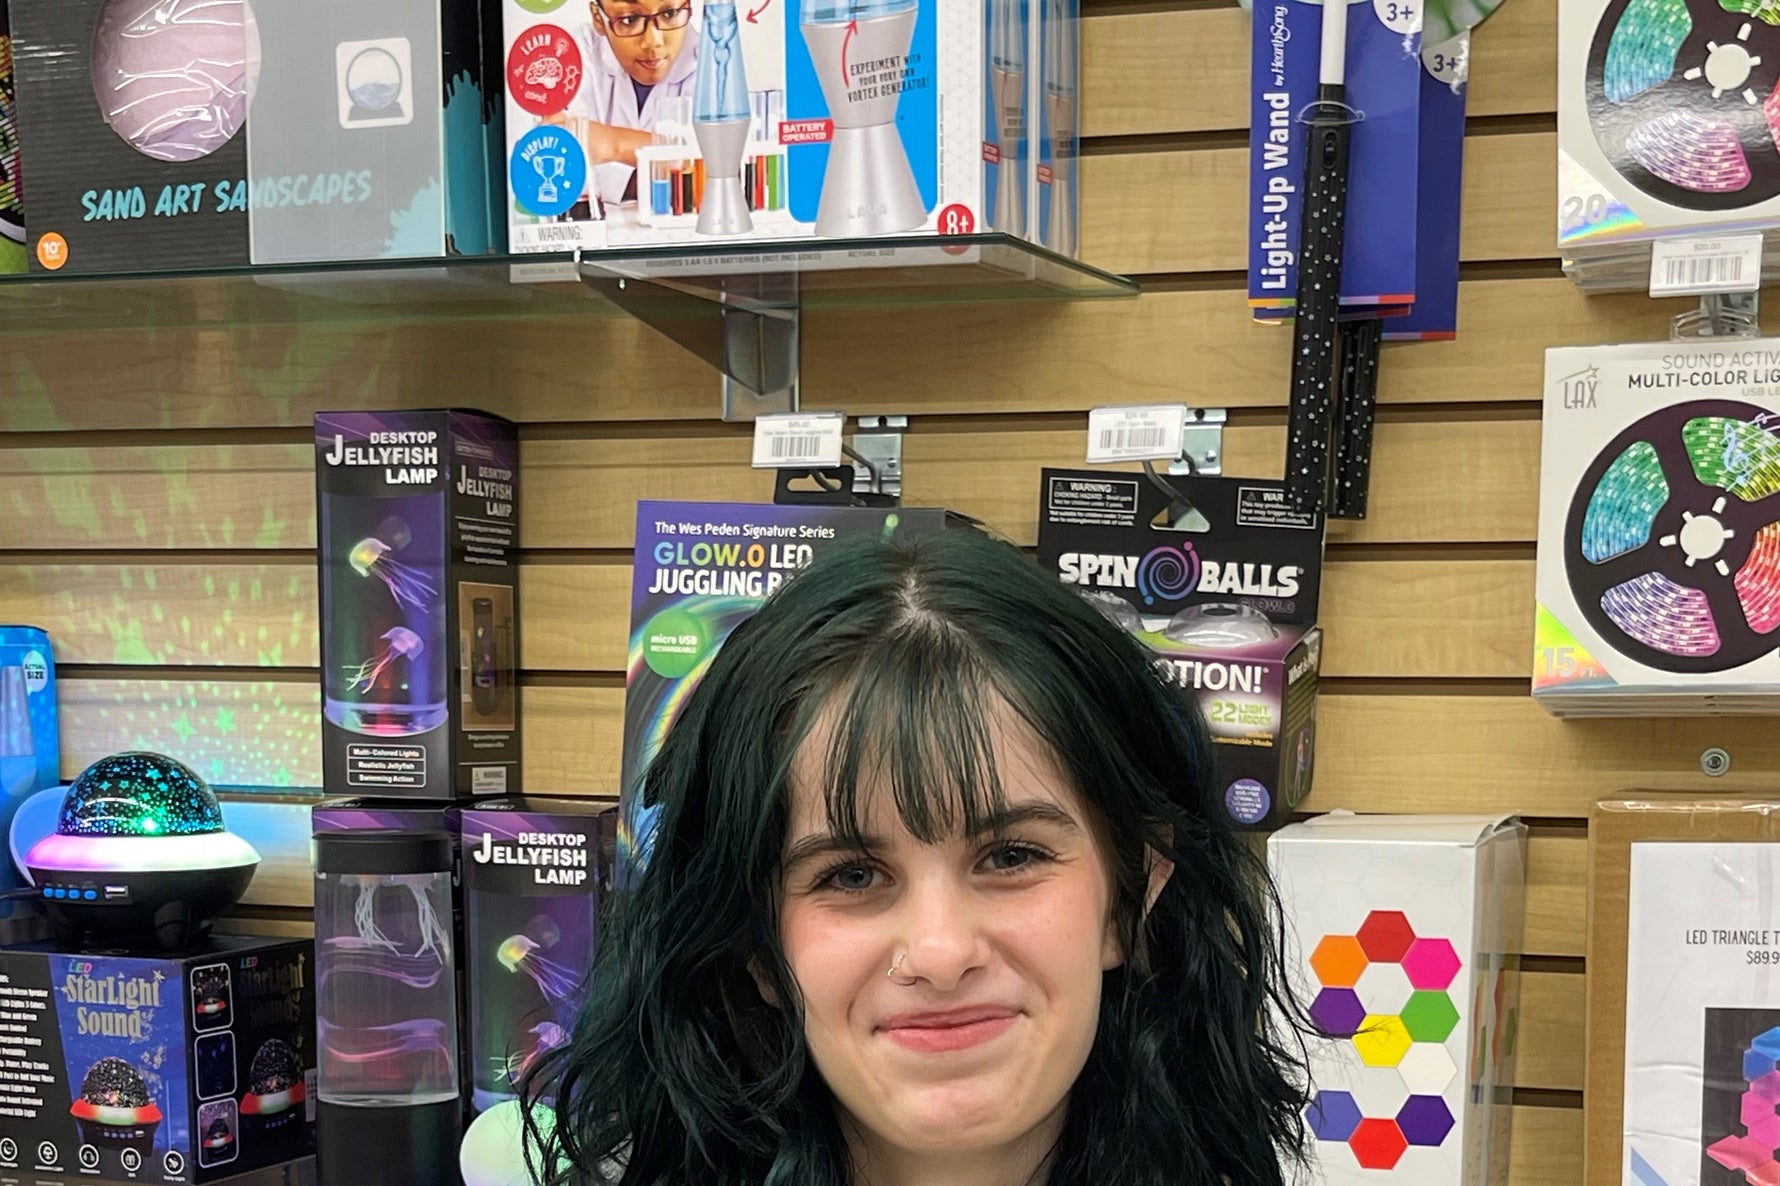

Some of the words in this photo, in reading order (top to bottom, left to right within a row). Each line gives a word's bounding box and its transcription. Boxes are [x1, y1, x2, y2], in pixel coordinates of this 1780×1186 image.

[1386, 3, 1413, 21] 3+
[850, 56, 901, 76] EXPERIMENT
[1433, 54, 1457, 72] 3+
[847, 87, 878, 103] VORTEX
[782, 122, 826, 135] BATTERY
[782, 132, 827, 141] OPERATED
[1262, 92, 1291, 170] Wand
[81, 186, 147, 222] SAND
[154, 182, 206, 217] ART
[213, 169, 372, 213] SANDSCAPES
[1564, 194, 1605, 228] 20
[946, 211, 969, 235] 8+
[1261, 176, 1296, 290] Light-Up
[1662, 354, 1724, 370] SOUND
[1628, 370, 1748, 389] MULTI-COLOR
[1564, 380, 1598, 409] LAX
[1742, 387, 1764, 396] USB
[370, 431, 438, 445] DESKTOP
[326, 434, 438, 466] JELLYFISH
[385, 468, 438, 484] LAMP
[457, 464, 512, 501] JELLYFISH
[479, 466, 512, 481] DESKTOP
[486, 502, 512, 517] LAMP
[655, 522, 675, 535] The
[679, 523, 702, 535] Wes
[704, 524, 740, 536] Peden
[742, 525, 796, 540] Signature
[799, 525, 835, 539] Series
[770, 544, 813, 569] LED
[1058, 553, 1139, 587] SPIN
[648, 569, 762, 597] JUGGLING
[1197, 562, 1299, 598] BALLS
[650, 634, 677, 644] micro
[679, 635, 698, 646] USB
[1543, 647, 1576, 677] 15
[1210, 701, 1238, 723] 22
[519, 833, 586, 846] DESKTOP
[473, 833, 586, 867] JELLYFISH
[535, 869, 586, 885] LAMP
[1686, 929, 1707, 944] LED
[1712, 930, 1769, 945] TRIANGLE
[68, 960, 92, 974] LED
[241, 956, 258, 969] LED
[78, 1006, 142, 1038] Sound
